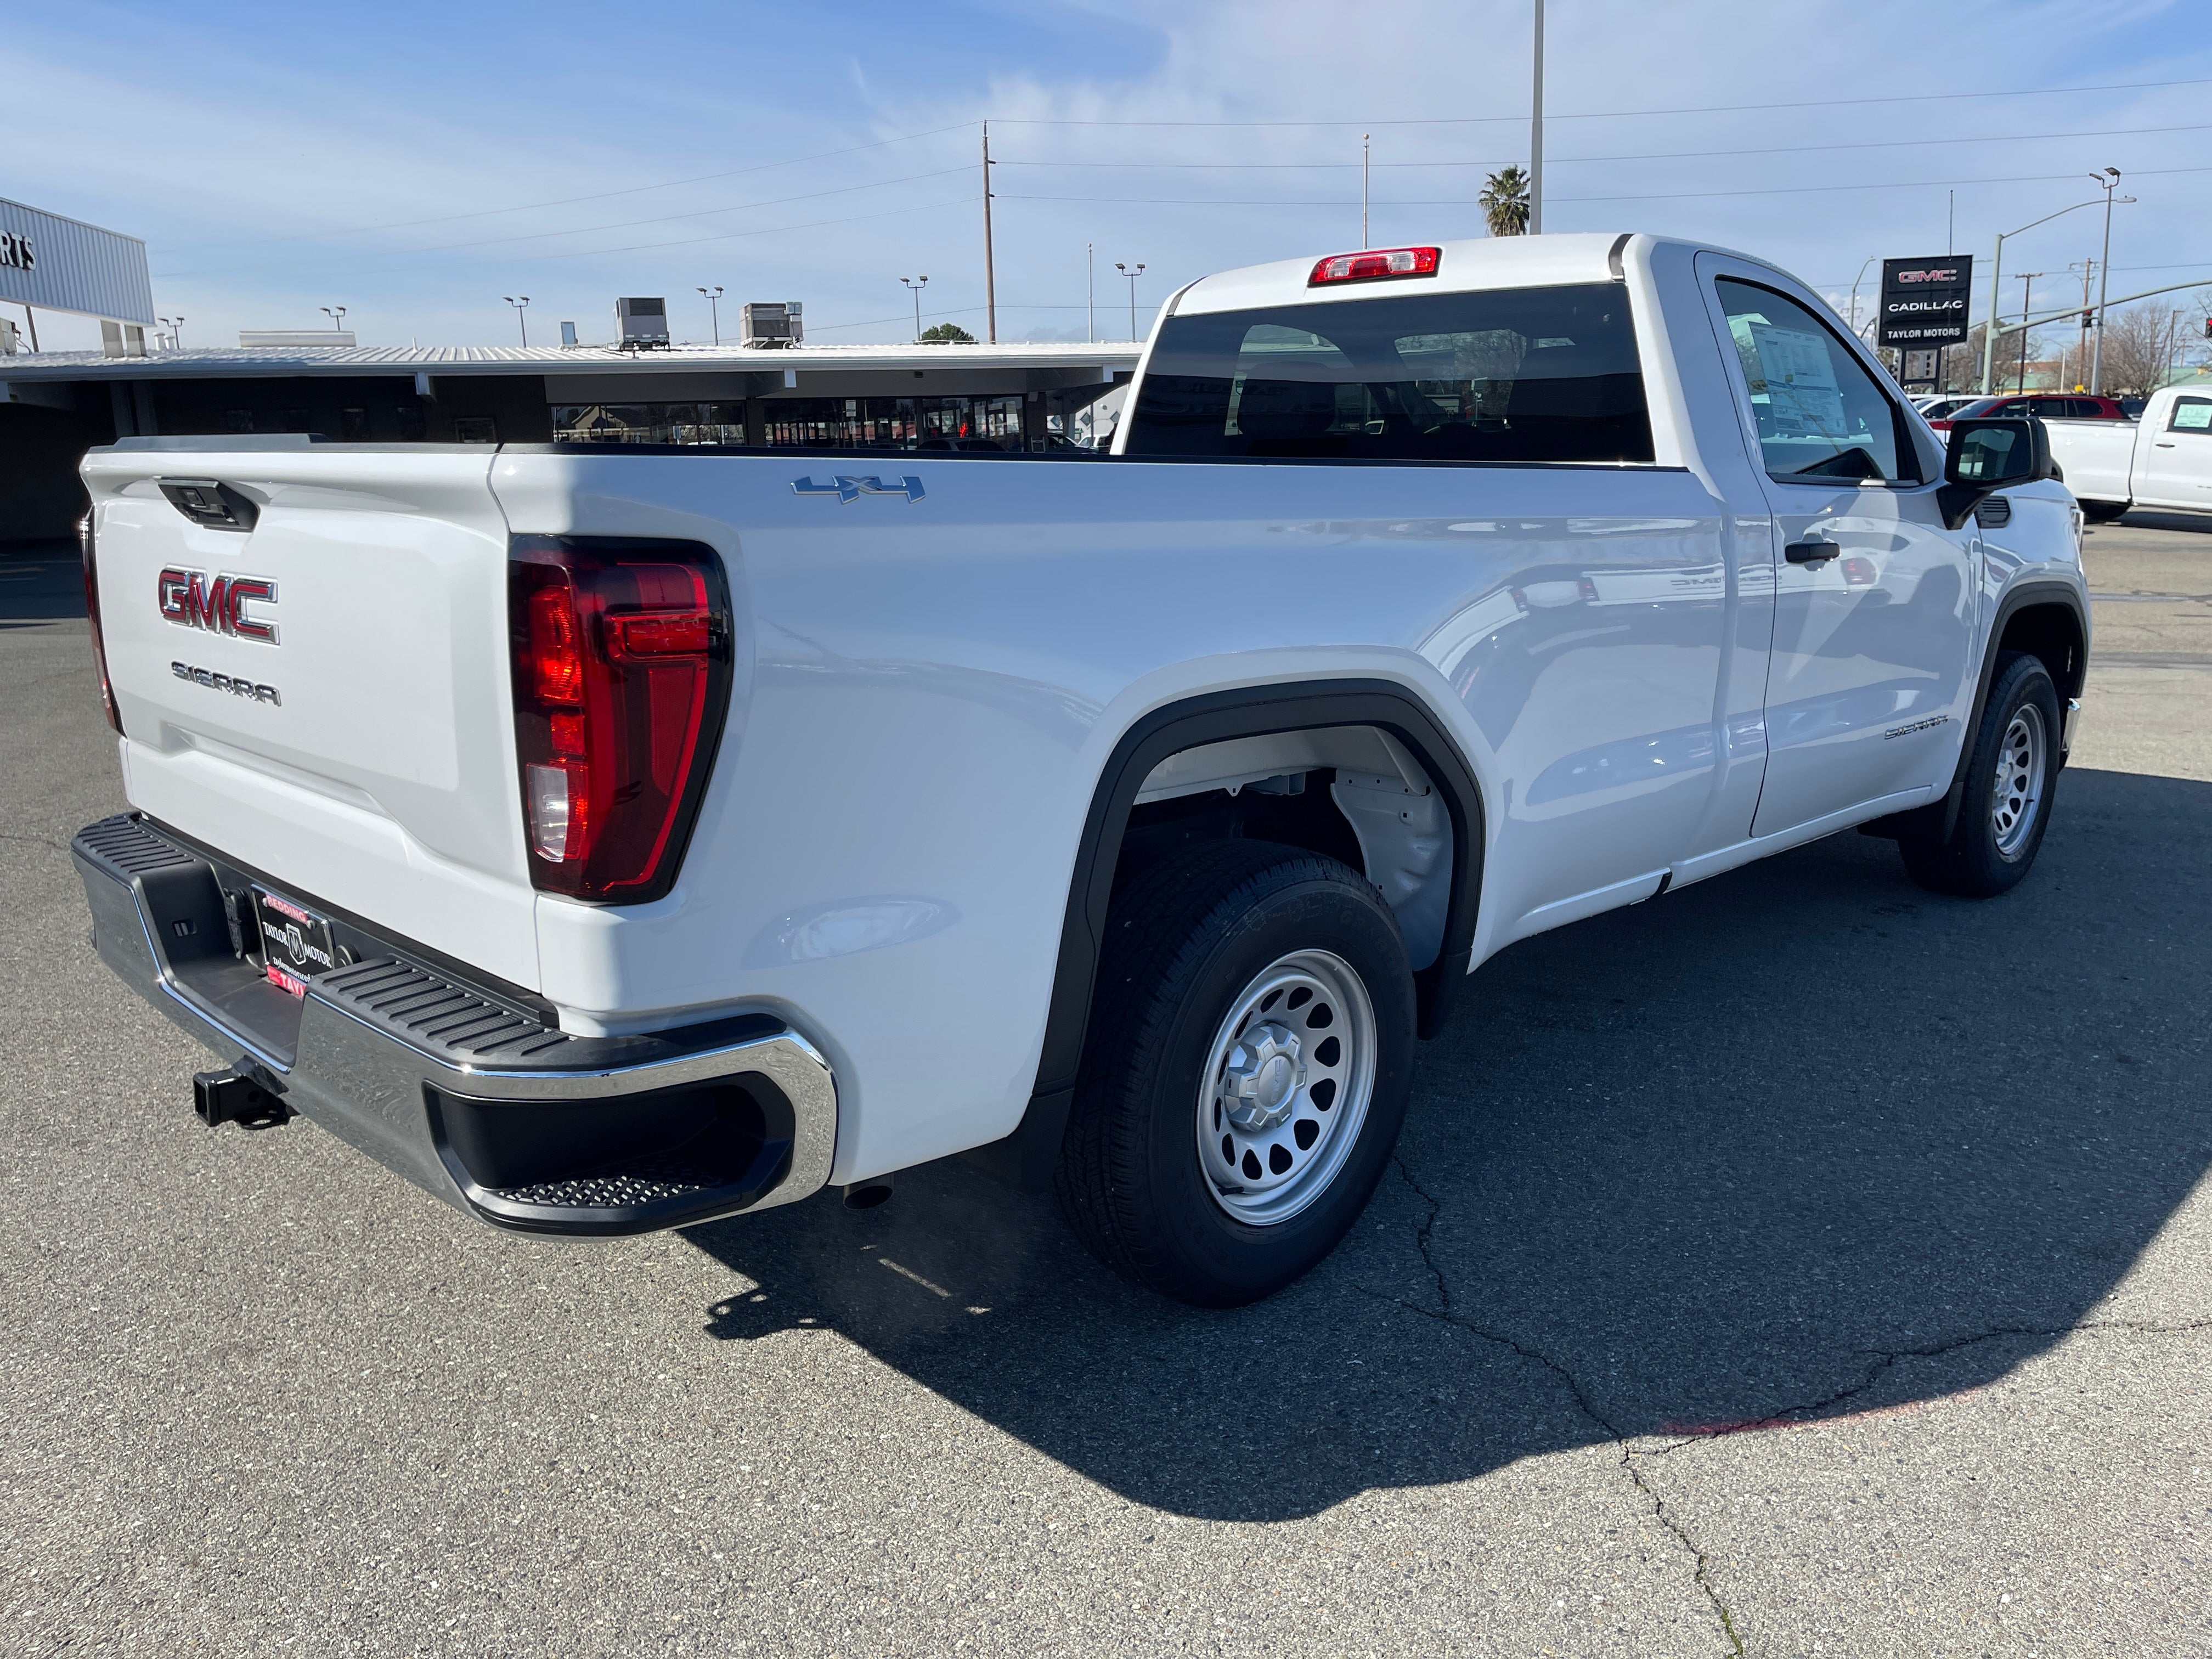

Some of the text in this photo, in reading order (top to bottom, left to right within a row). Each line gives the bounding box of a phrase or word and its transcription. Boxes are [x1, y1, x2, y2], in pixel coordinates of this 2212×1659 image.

[1898, 269, 1957, 284] GMC
[1888, 300, 1963, 312] CADILLAC
[1887, 328, 1960, 339] TAYLOR MOTORS
[158, 566, 281, 646] GMC
[171, 661, 281, 707] SIERRA
[1884, 714, 1949, 740] SIERRA
[267, 895, 307, 921] REDDING
[263, 921, 289, 946] TAYLOR
[304, 943, 332, 968] MOTOR
